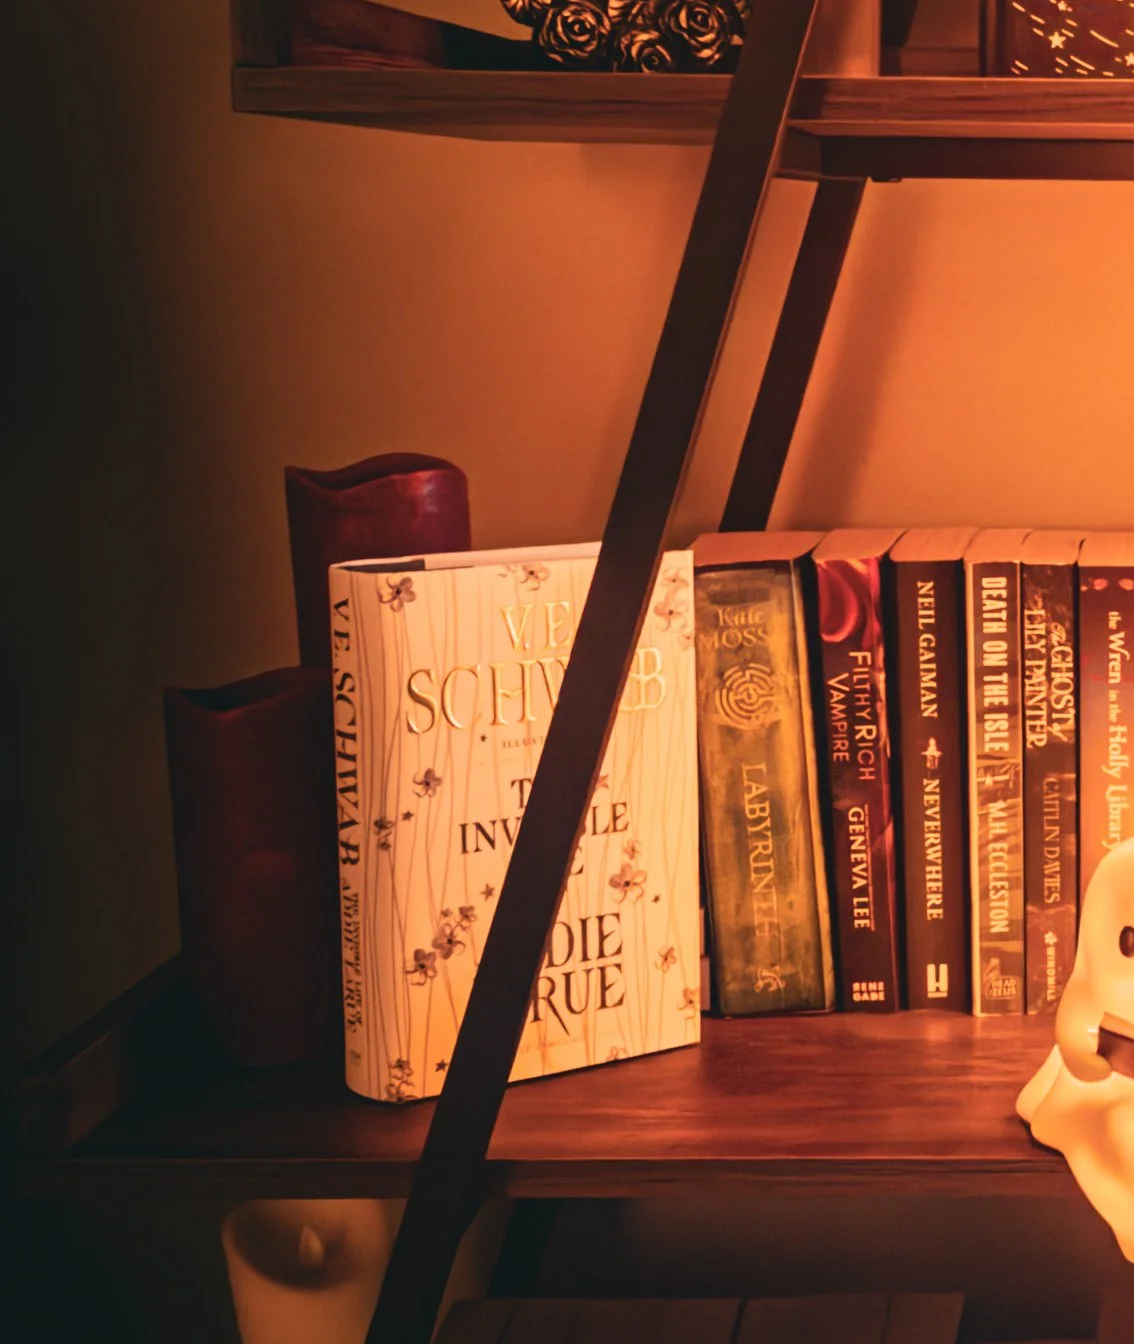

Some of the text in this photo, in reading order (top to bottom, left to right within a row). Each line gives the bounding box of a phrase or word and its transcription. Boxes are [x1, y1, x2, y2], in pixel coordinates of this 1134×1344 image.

[718, 608, 765, 626] Kate
[916, 580, 939, 717] NEIL GAIMAN
[982, 577, 1009, 752] DEATH ON THE ISLE
[1025, 608, 1048, 749] LILY PAINTER
[1047, 623, 1073, 740] The GHOST of
[1101, 611, 1129, 852] the Wren in the Holly Library
[333, 668, 360, 866] SCHWAB
[741, 762, 779, 937] LABYRINTH
[848, 806, 870, 929] GENEVA LEE
[922, 778, 944, 921] NEVERWHERE
[988, 842, 1009, 933] ECCLESTON
[1043, 777, 1060, 904] CAITLIN DAVIES
[852, 981, 885, 992] RENE
[852, 992, 885, 1002] GADE
[1045, 946, 1056, 1002] WINDMILL
